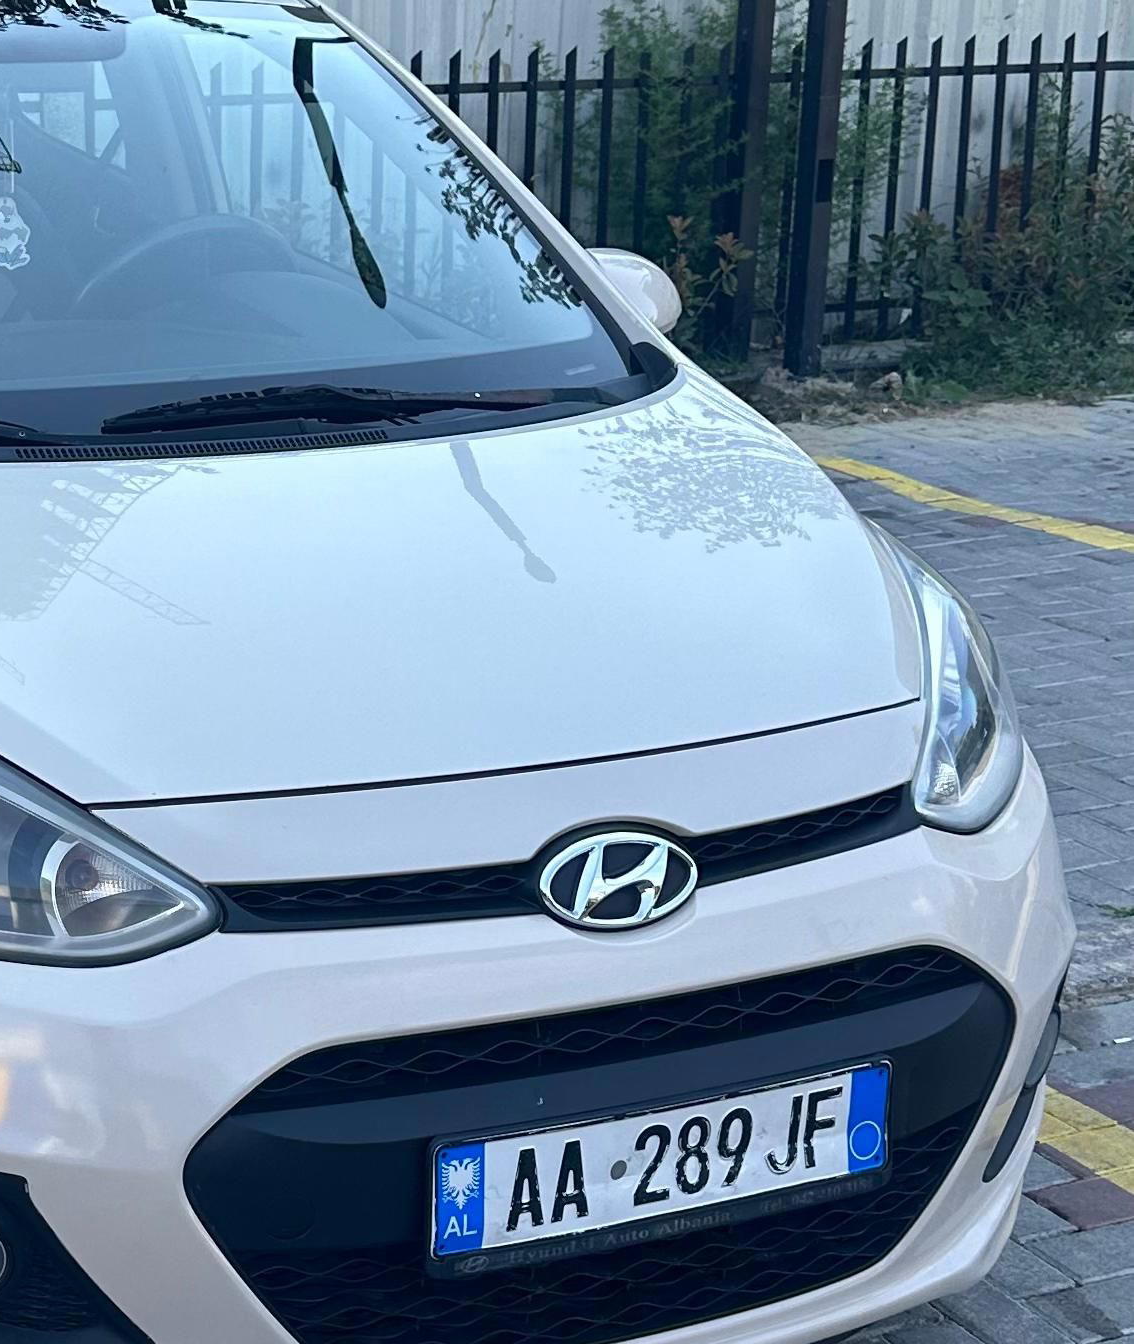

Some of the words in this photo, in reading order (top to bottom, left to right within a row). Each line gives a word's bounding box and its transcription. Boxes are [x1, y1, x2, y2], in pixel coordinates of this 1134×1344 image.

[506, 1140, 589, 1233] AA
[633, 1107, 754, 1207] 289
[765, 1086, 844, 1174] JF
[443, 1215, 478, 1241] AL
